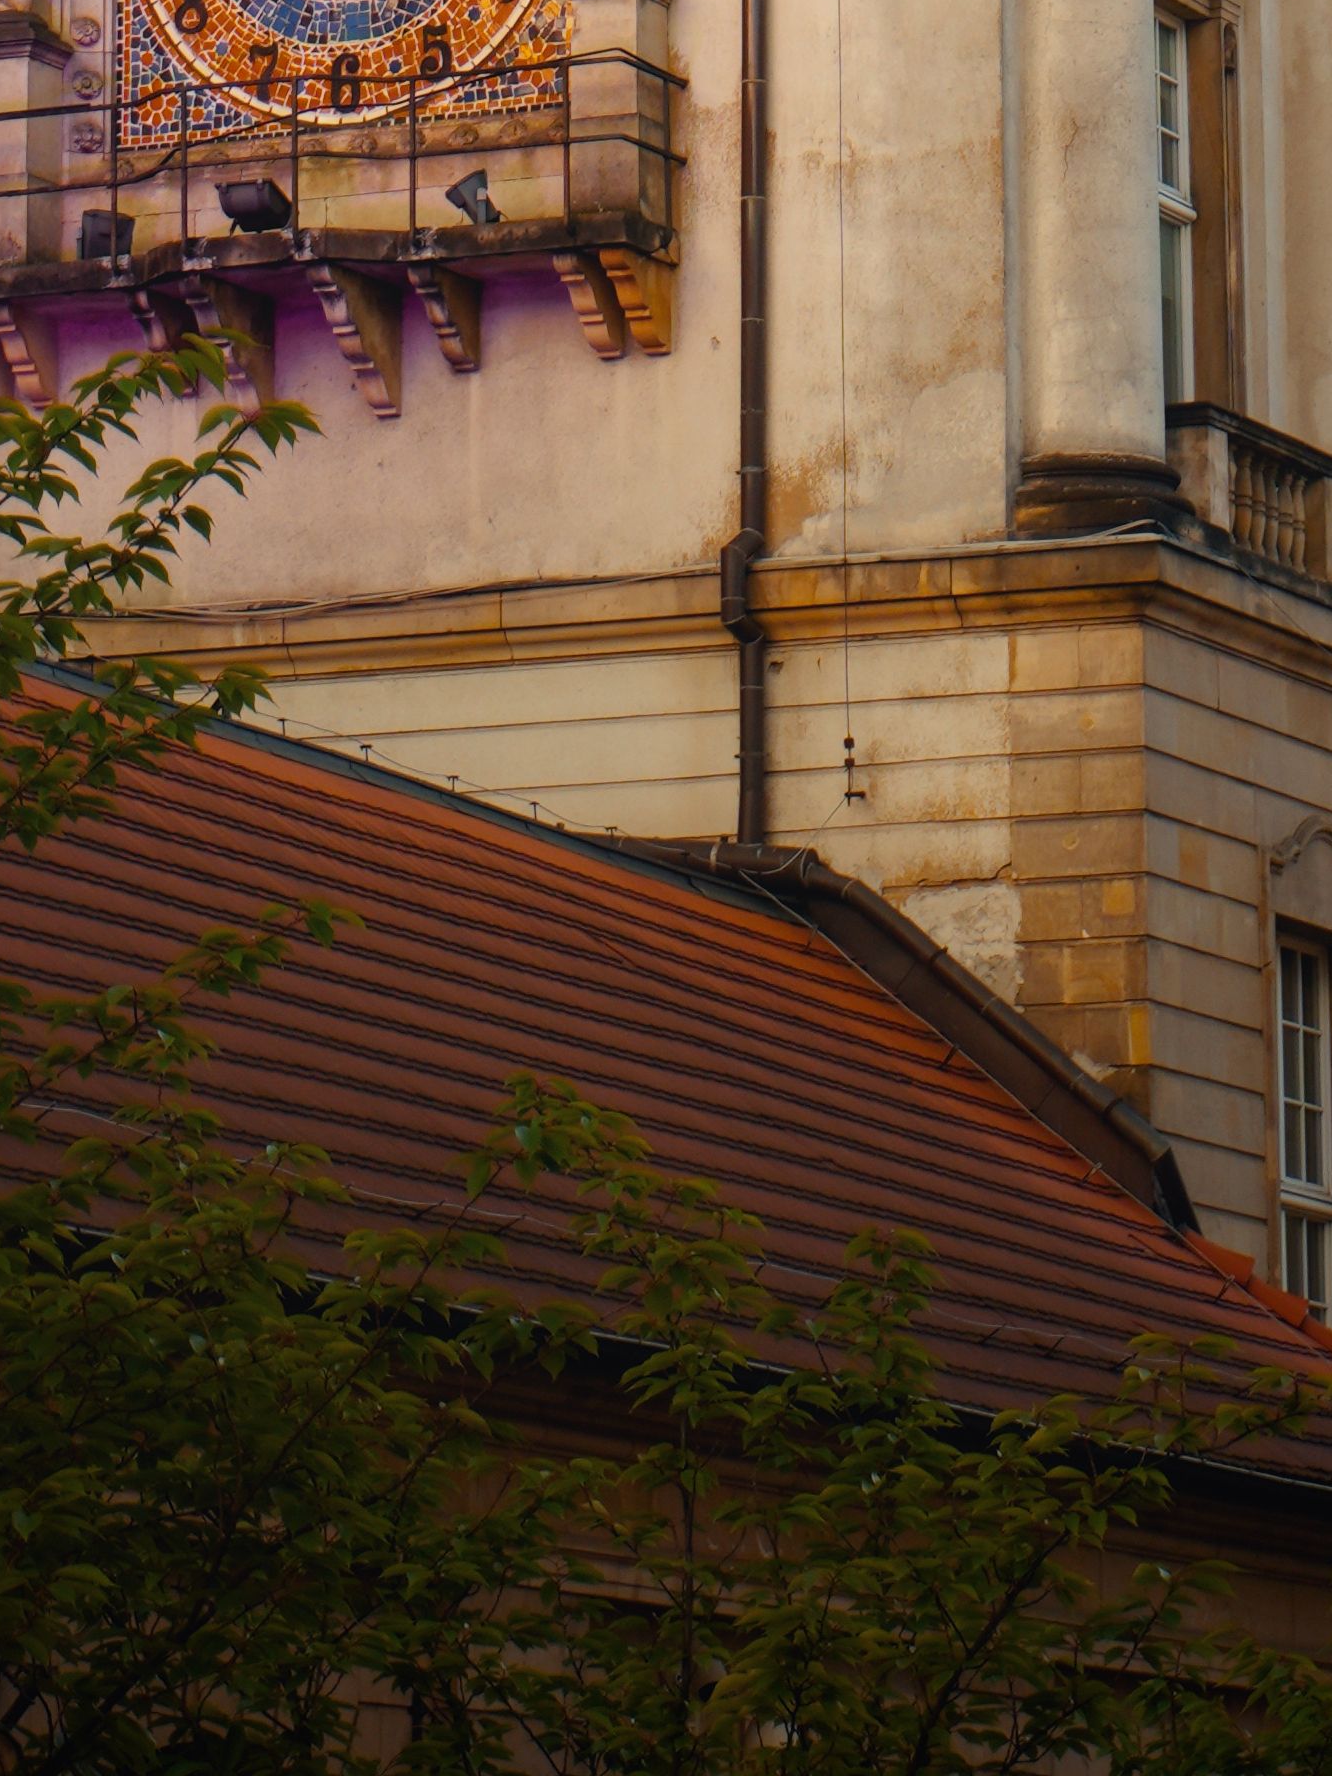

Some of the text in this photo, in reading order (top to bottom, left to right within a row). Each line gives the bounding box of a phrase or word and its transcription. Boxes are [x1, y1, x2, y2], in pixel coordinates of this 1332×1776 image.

[251, 44, 278, 102] 7
[421, 25, 451, 77] 5
[331, 53, 360, 112] 6
